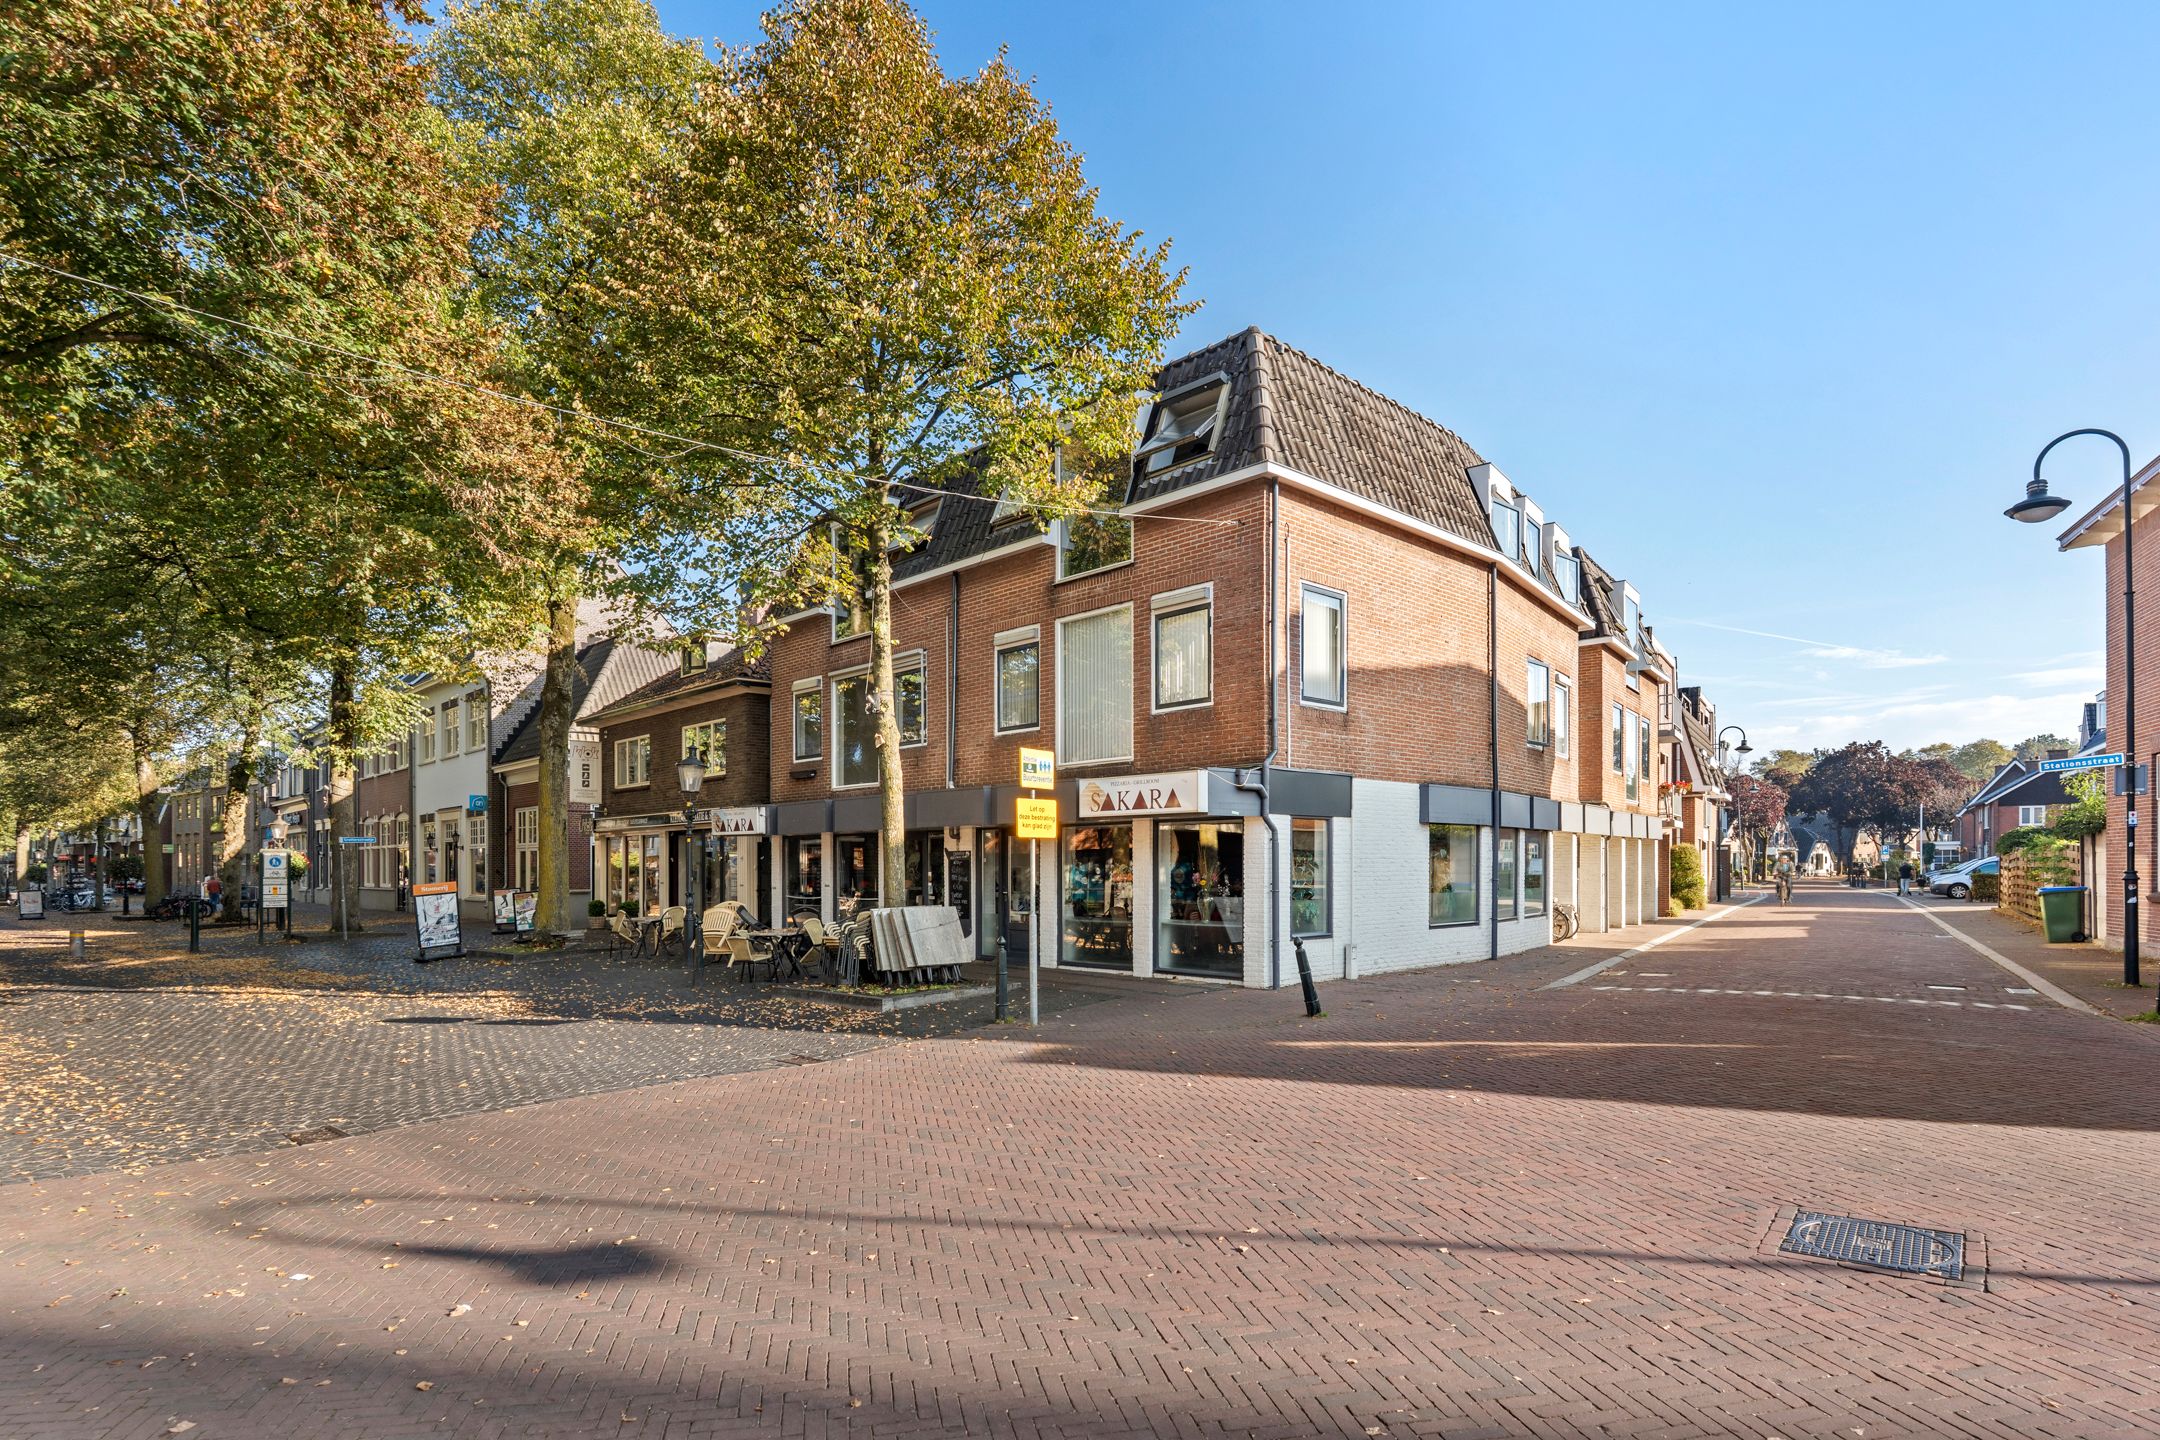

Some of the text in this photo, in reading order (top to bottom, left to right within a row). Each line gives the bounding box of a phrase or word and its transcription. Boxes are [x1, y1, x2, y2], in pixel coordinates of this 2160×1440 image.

[2043, 756, 2120, 770] Stationsstraat
[1090, 788, 1182, 812] SAKARA
[715, 818, 754, 832] SAKARA
[1031, 814, 1055, 822] bestrating
[1032, 823, 1042, 831] glad
